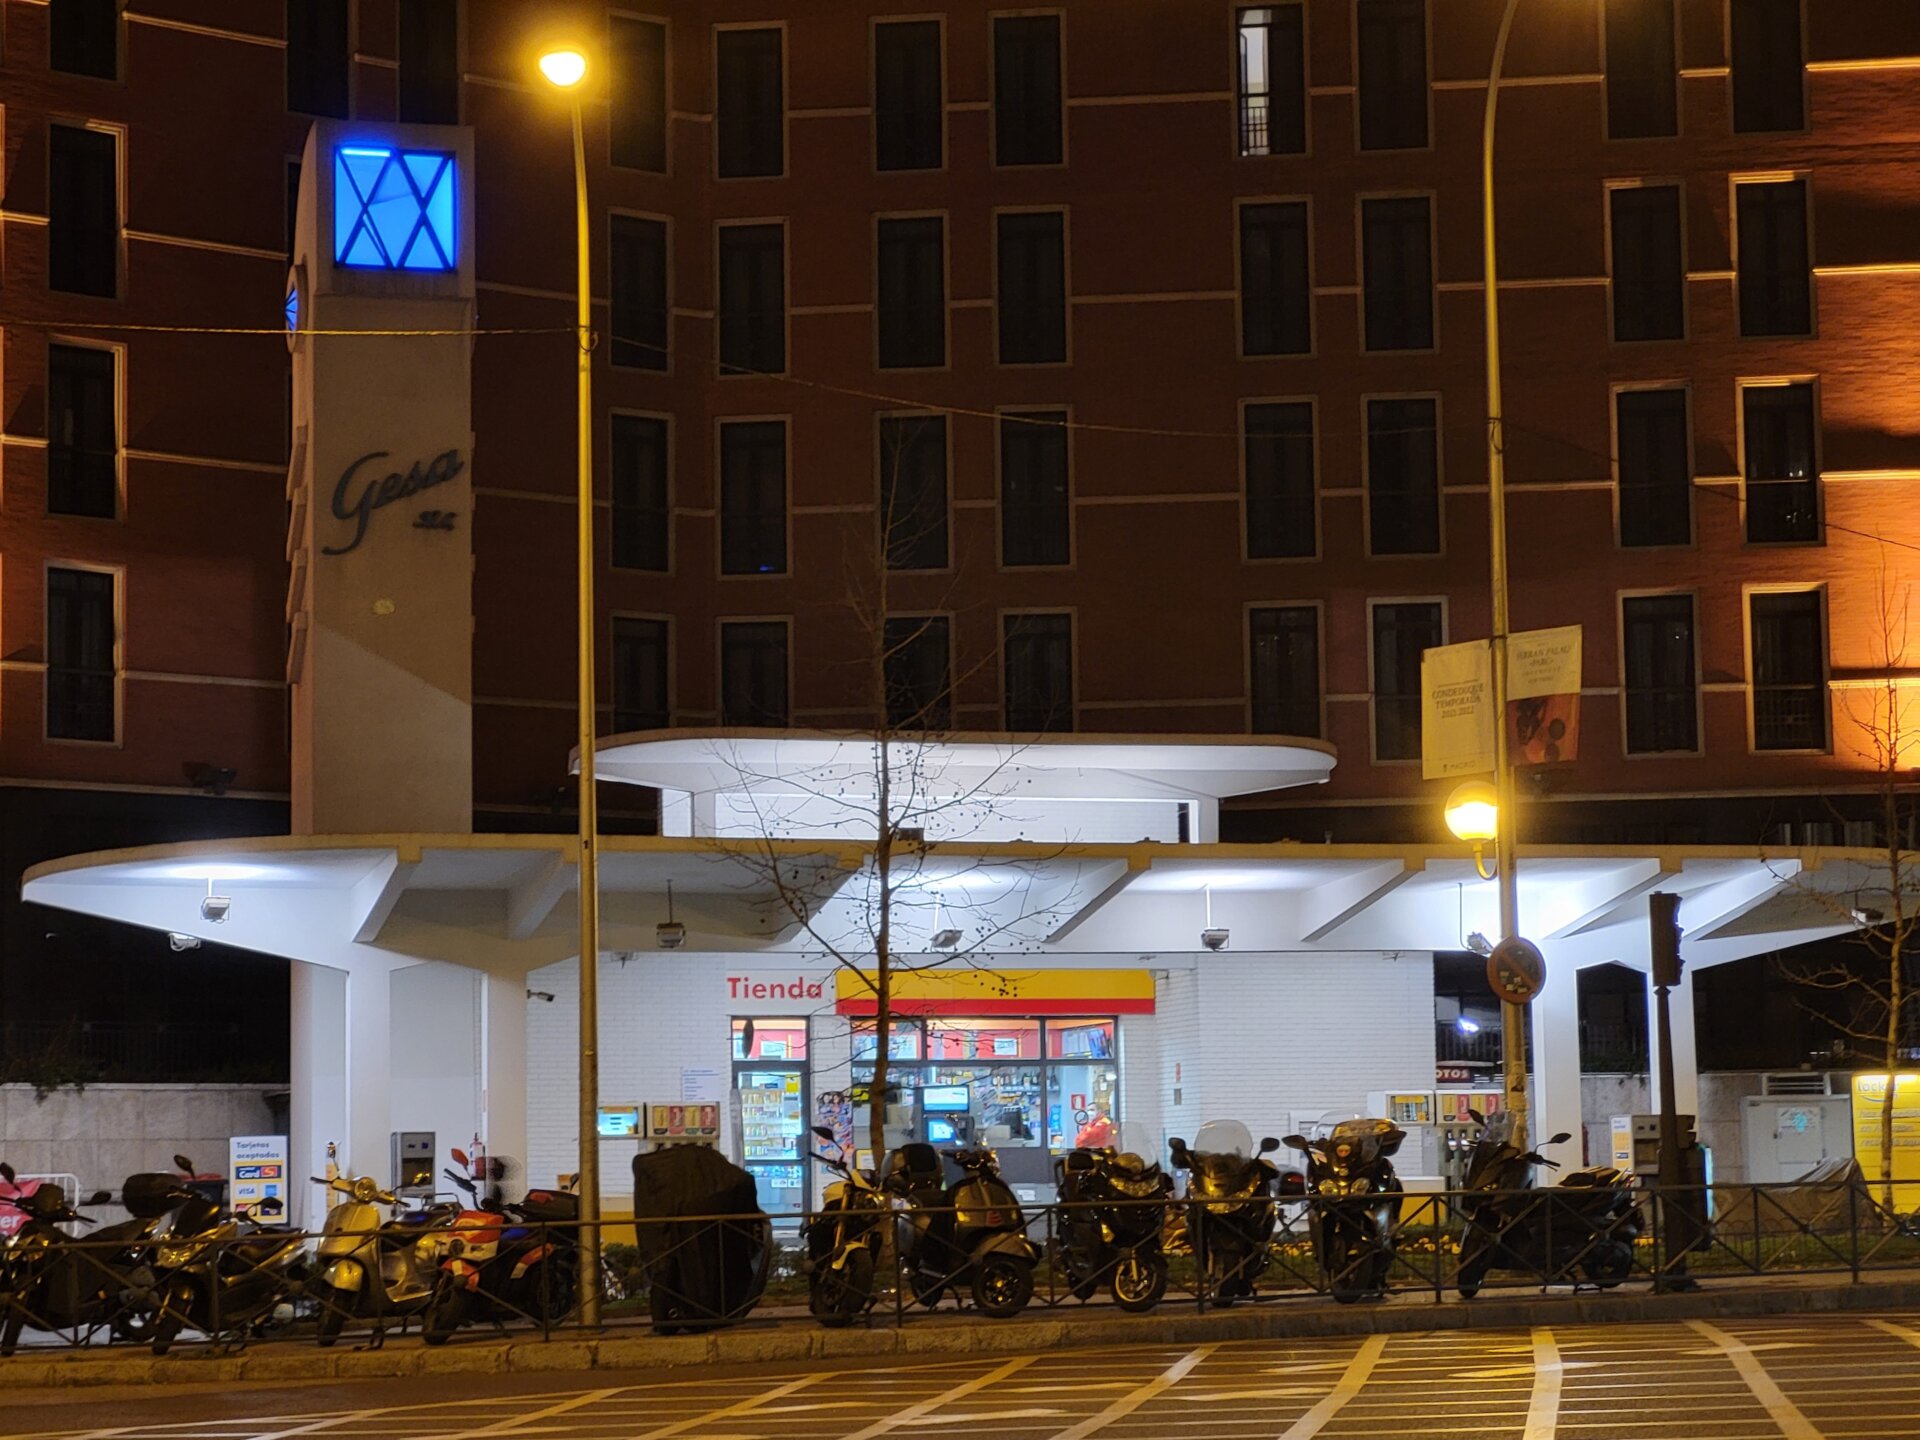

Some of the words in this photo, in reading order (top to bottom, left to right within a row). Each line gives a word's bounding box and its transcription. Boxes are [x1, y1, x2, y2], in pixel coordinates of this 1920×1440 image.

[321, 449, 464, 555] Gesa
[727, 976, 822, 999] Tienda
[236, 1142, 270, 1150] Tarjetas
[236, 1152, 280, 1160] aceptadas
[239, 1187, 255, 1195] VISA
[0, 1215, 21, 1228] er
